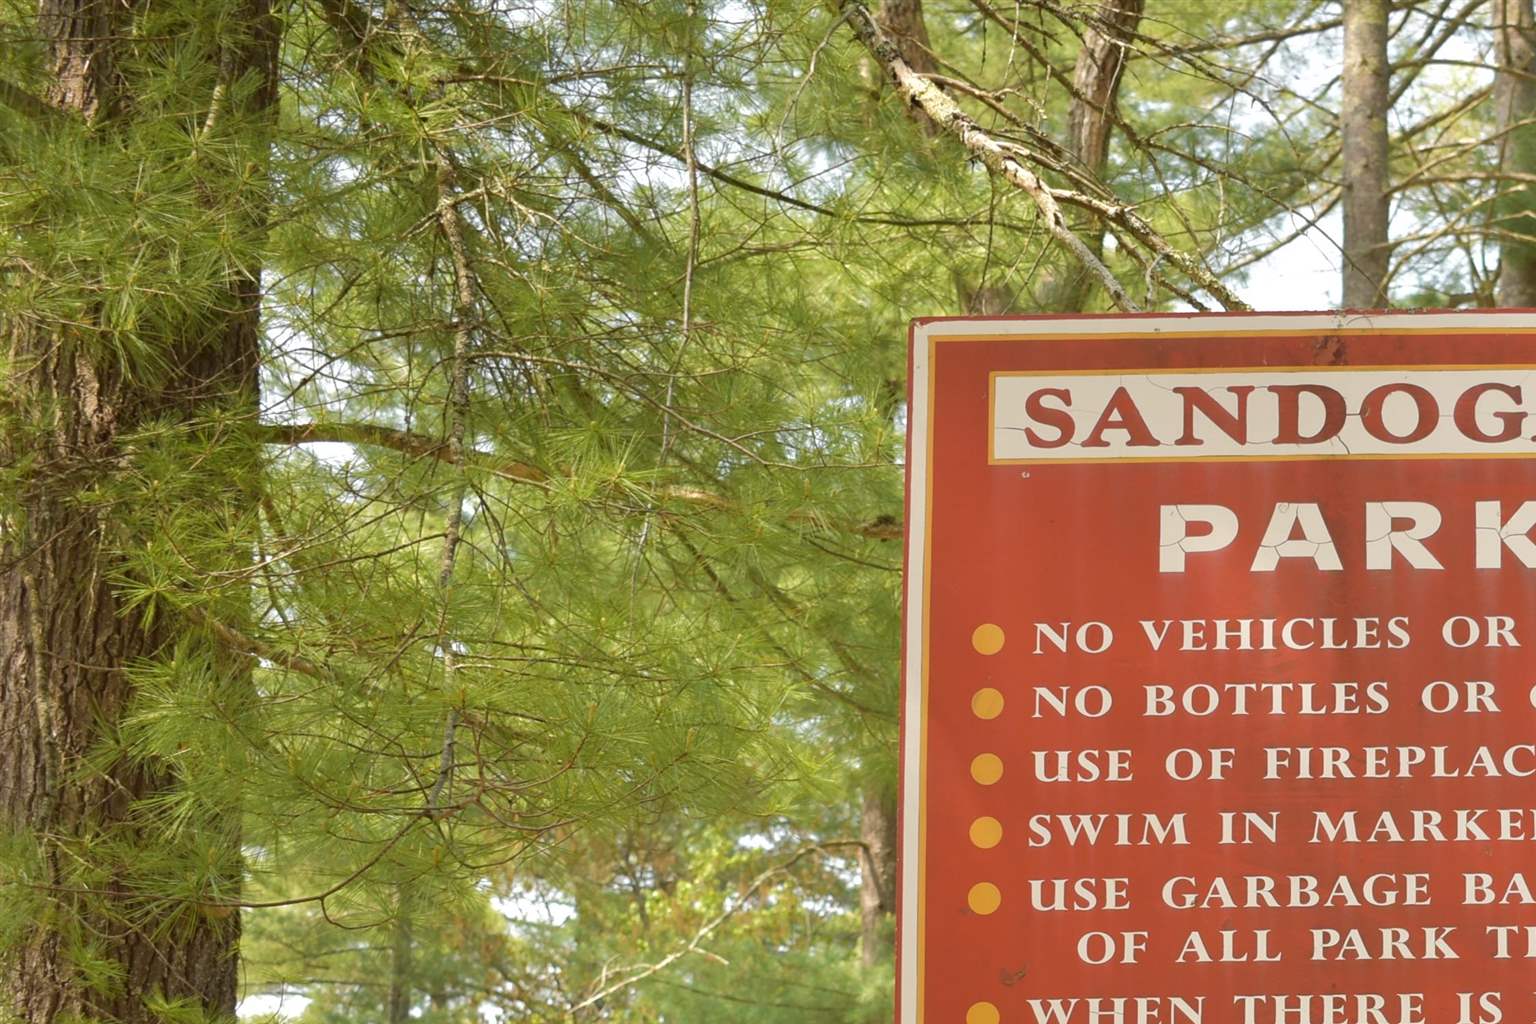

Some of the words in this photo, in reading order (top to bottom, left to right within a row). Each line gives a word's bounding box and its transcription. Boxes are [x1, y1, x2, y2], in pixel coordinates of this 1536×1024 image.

[1034, 621, 1114, 654] NO
[1139, 616, 1411, 651] VEHICLES
[1442, 615, 1520, 648] OR
[1033, 685, 1113, 718] NO
[1144, 681, 1390, 716] BOTTLES
[1421, 681, 1501, 714] OR
[1033, 749, 1133, 783] USE
[1165, 747, 1236, 781] OF
[1028, 813, 1189, 847] SWIM
[1220, 811, 1281, 844] IN
[1029, 877, 1130, 912] USE
[1162, 873, 1431, 910] GARBAGE
[1077, 931, 1148, 965] OF
[1177, 929, 1282, 963] ALL
[1311, 926, 1459, 961] PARK
